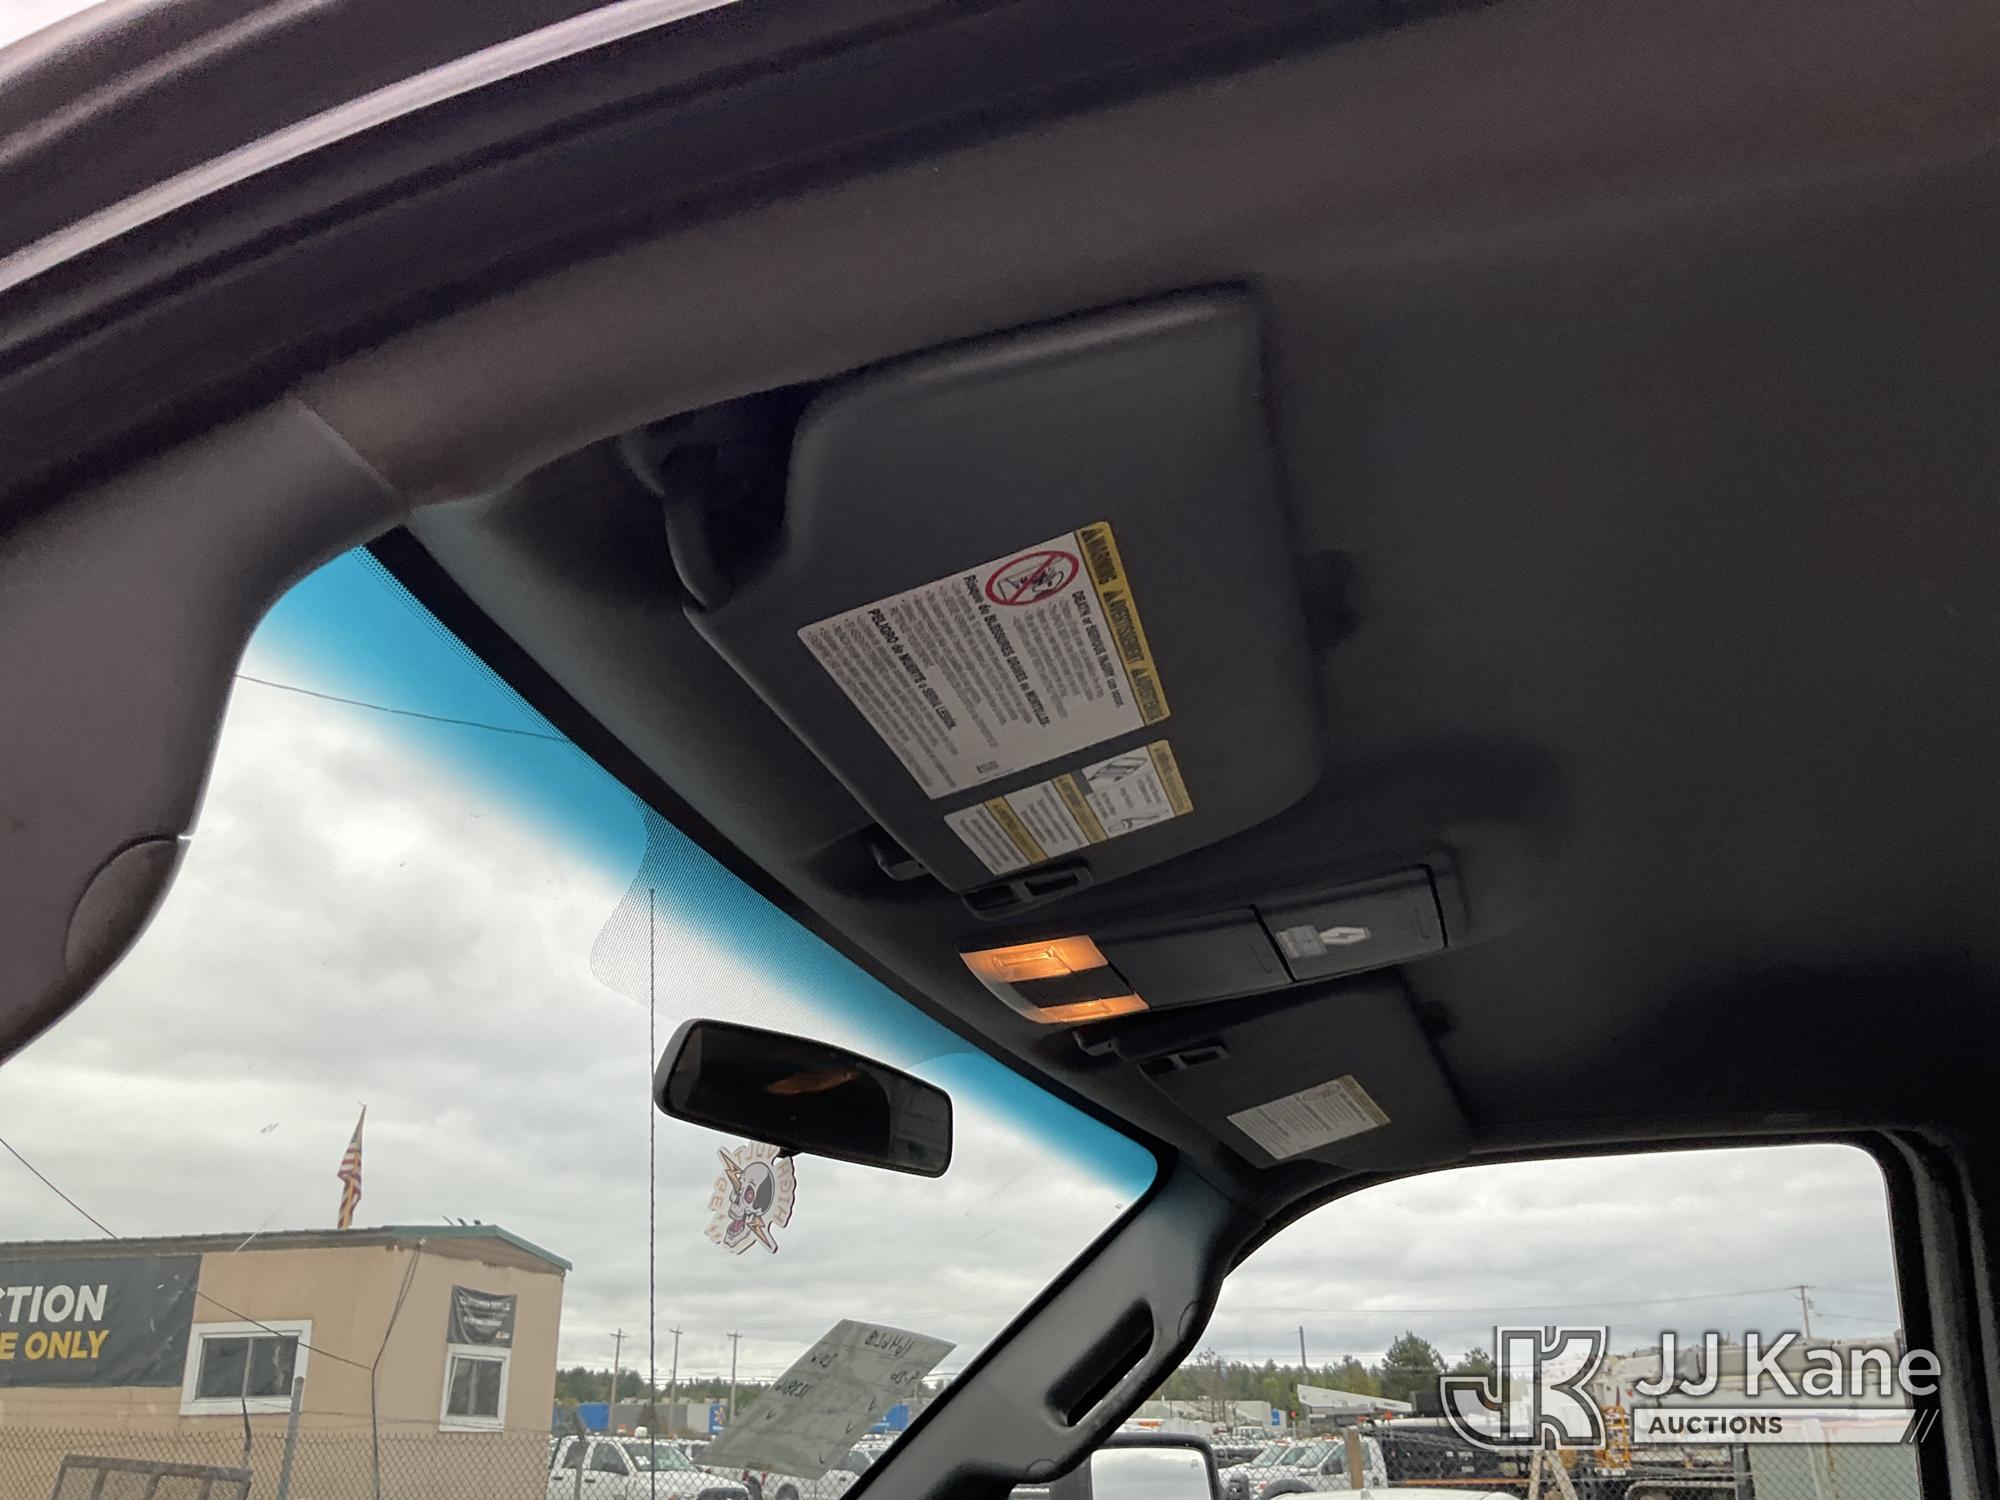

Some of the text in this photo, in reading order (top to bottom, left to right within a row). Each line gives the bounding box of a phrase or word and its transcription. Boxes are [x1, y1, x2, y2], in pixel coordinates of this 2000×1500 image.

[868, 608, 899, 643] PELIGRO
[0, 1285, 108, 1323] TION
[25, 1330, 109, 1359] ONLY
